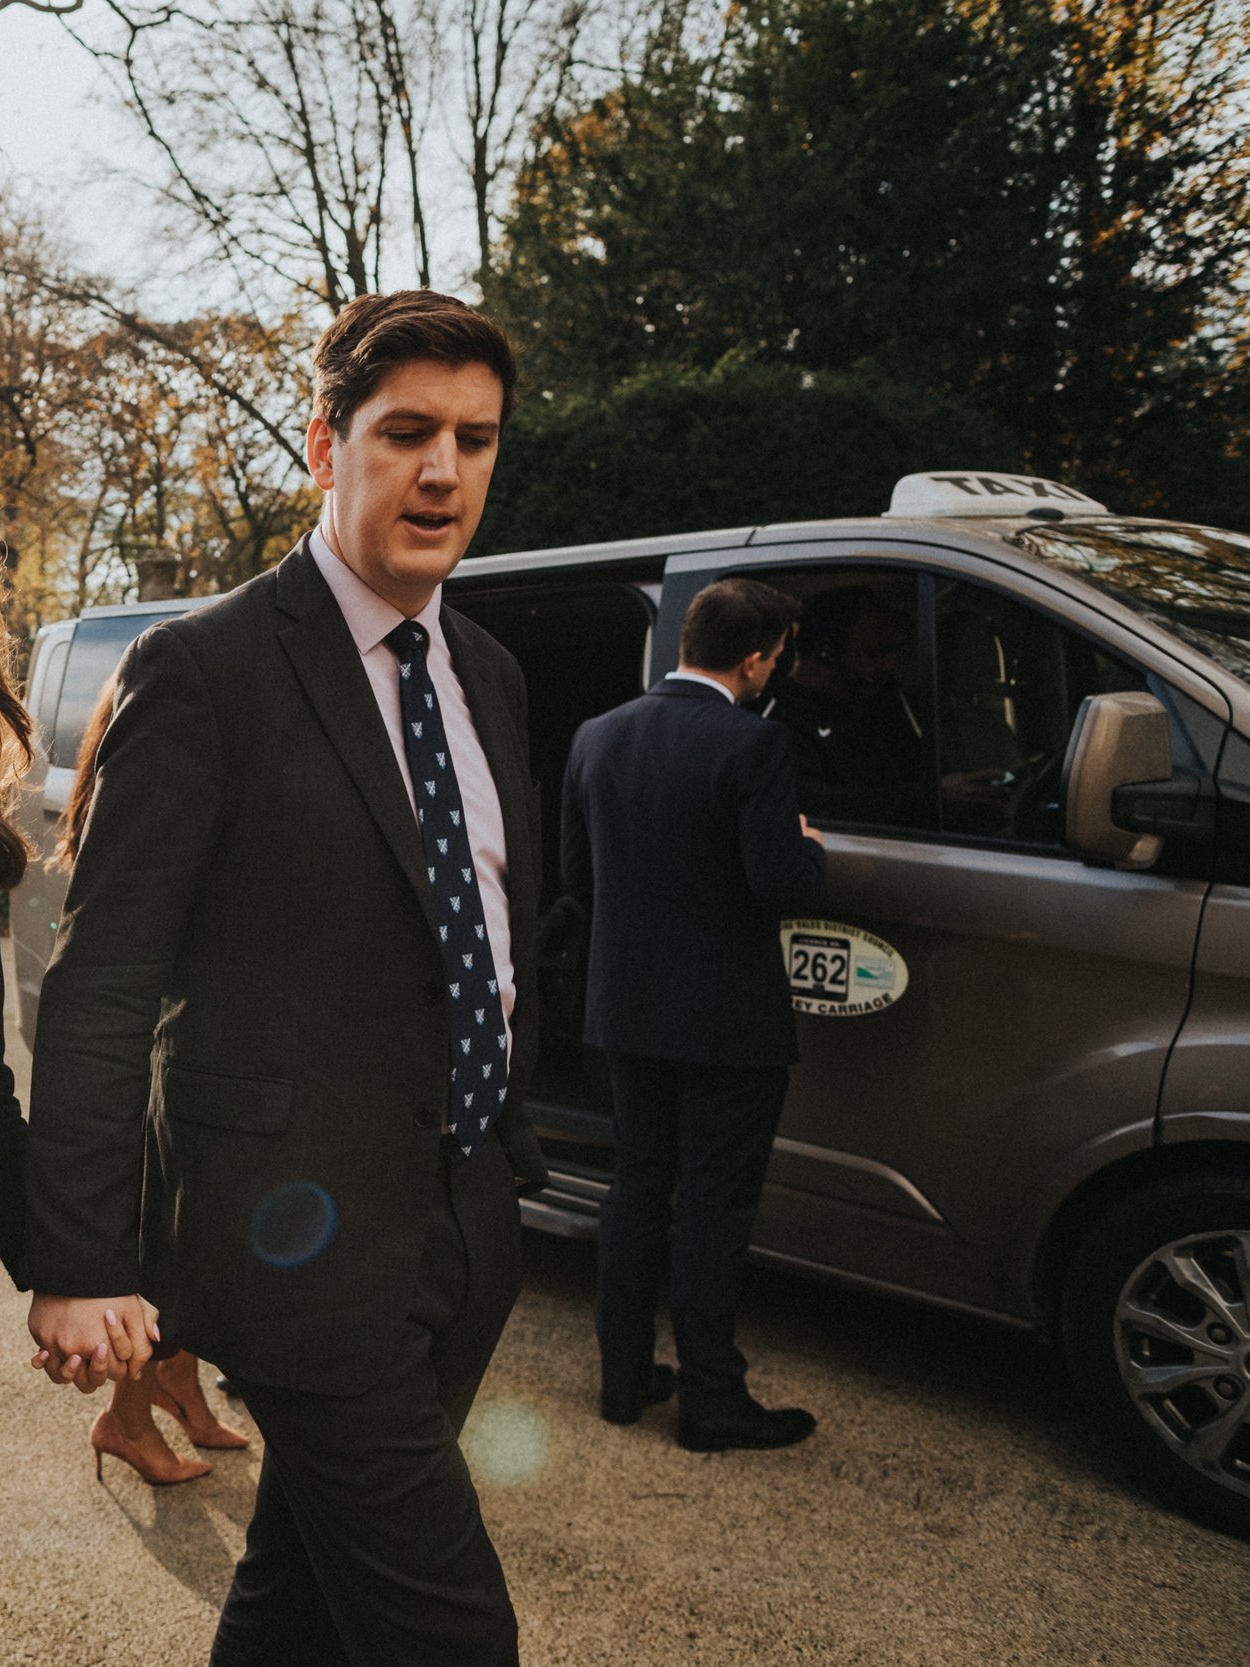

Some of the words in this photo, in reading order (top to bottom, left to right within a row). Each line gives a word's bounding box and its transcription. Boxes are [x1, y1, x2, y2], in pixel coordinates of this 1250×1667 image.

[931, 477, 1087, 502] TAXI
[793, 950, 846, 986] 262
[817, 992, 893, 1014] CARRIAGE
